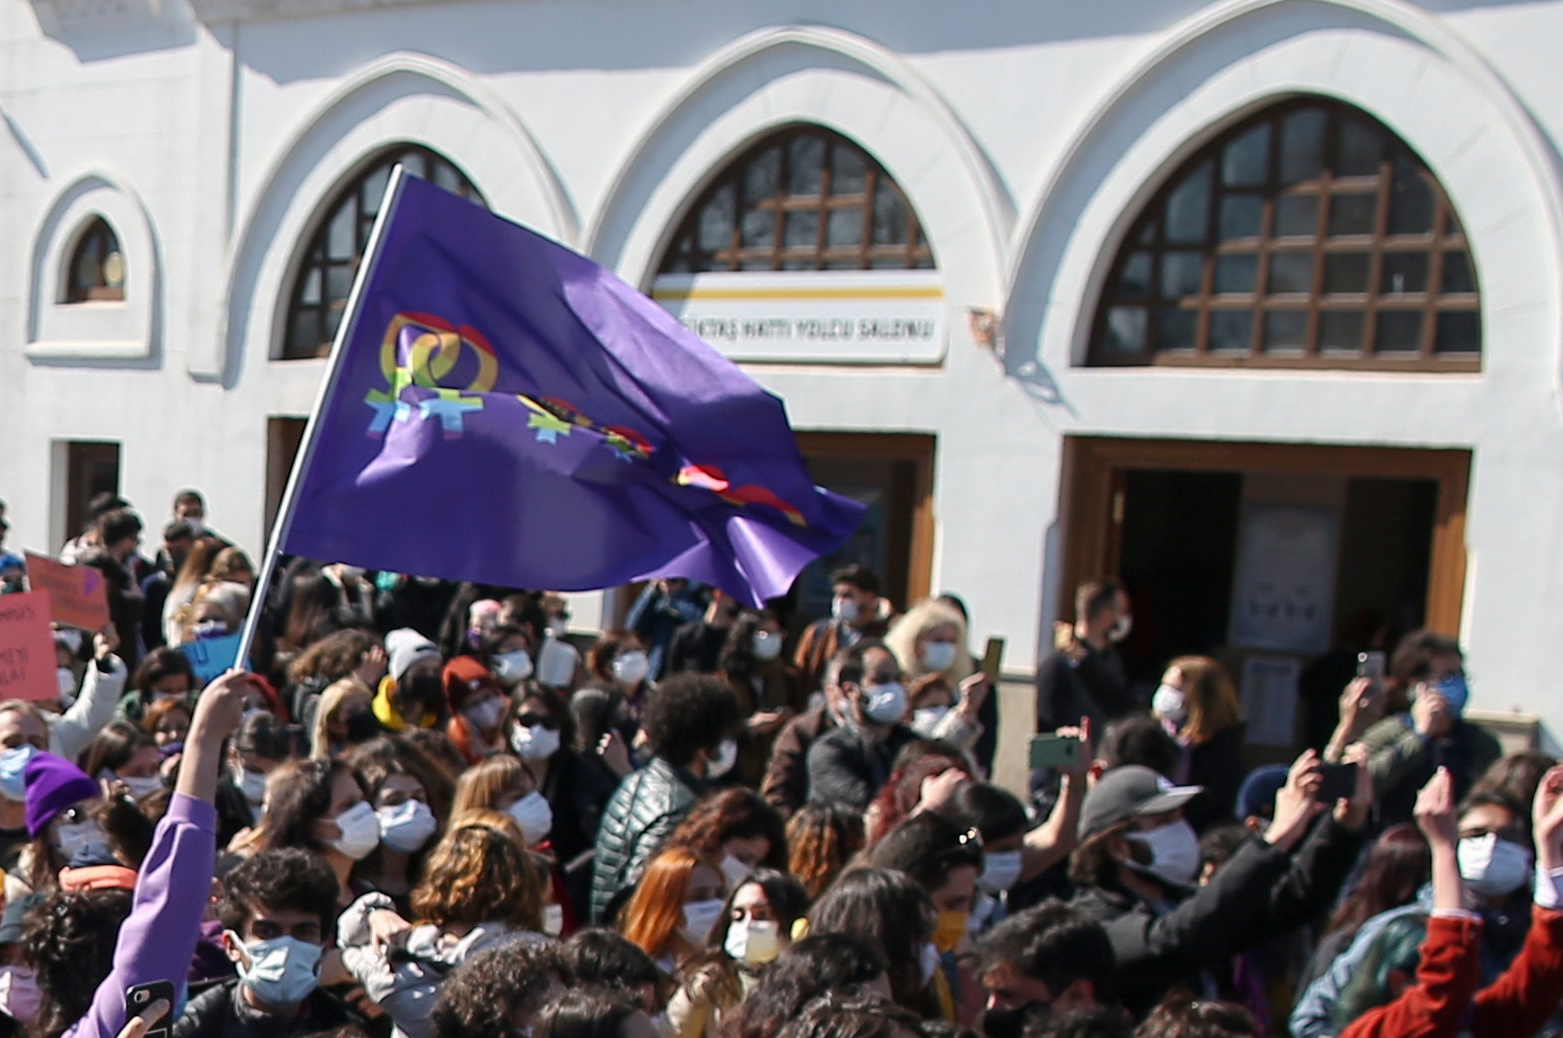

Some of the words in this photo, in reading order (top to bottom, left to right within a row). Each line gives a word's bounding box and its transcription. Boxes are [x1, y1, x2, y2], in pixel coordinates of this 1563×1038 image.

[742, 318, 792, 337] HATTI
[795, 318, 854, 337] YOLCU
[857, 318, 935, 338] SALONU
